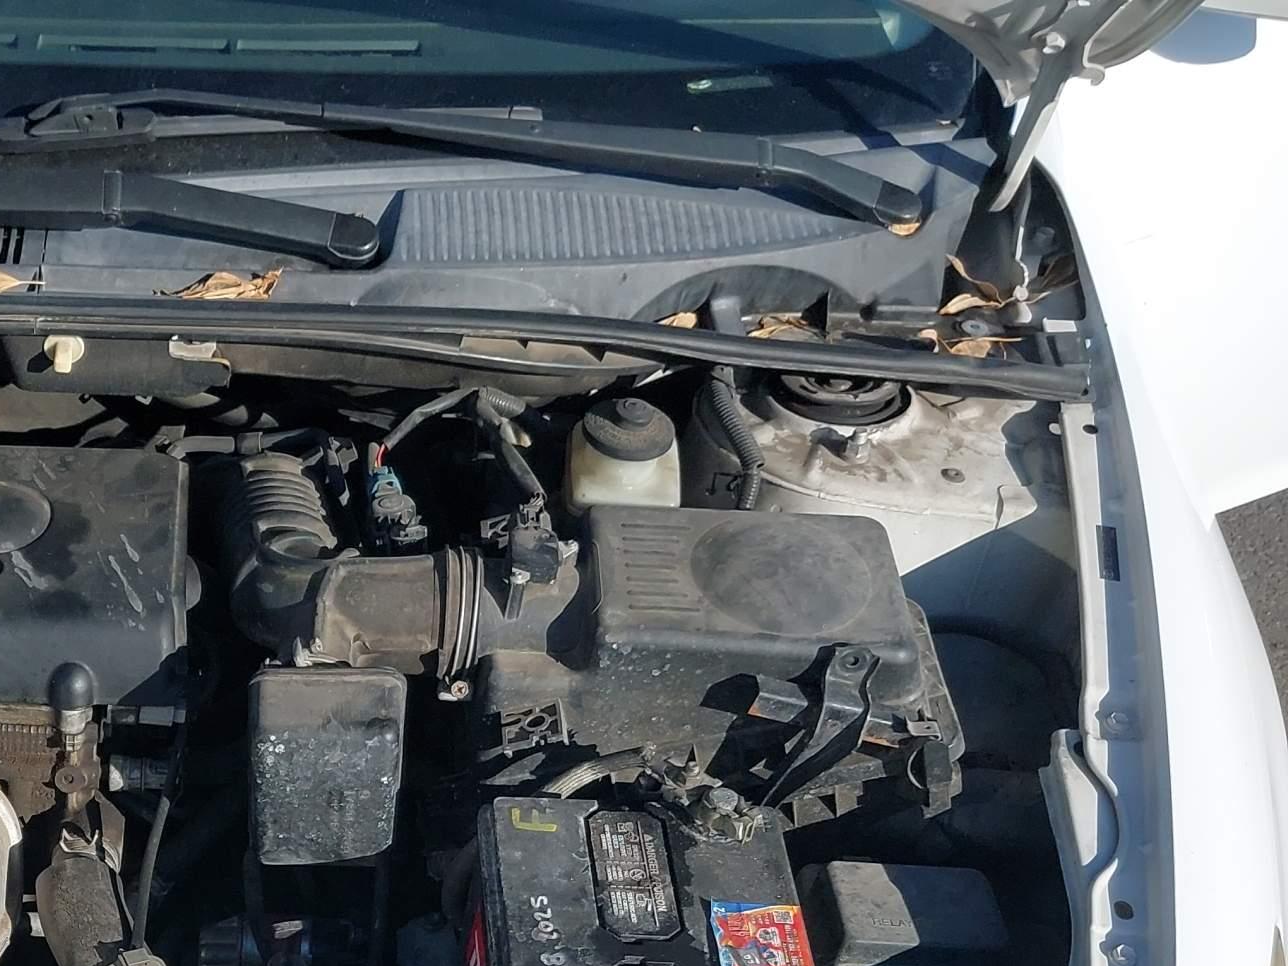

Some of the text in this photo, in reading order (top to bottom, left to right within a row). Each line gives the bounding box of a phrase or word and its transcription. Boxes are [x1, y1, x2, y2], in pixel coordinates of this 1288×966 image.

[646, 842, 660, 874] DANGER
[653, 882, 668, 911] POISON
[871, 917, 913, 929] RELAY
